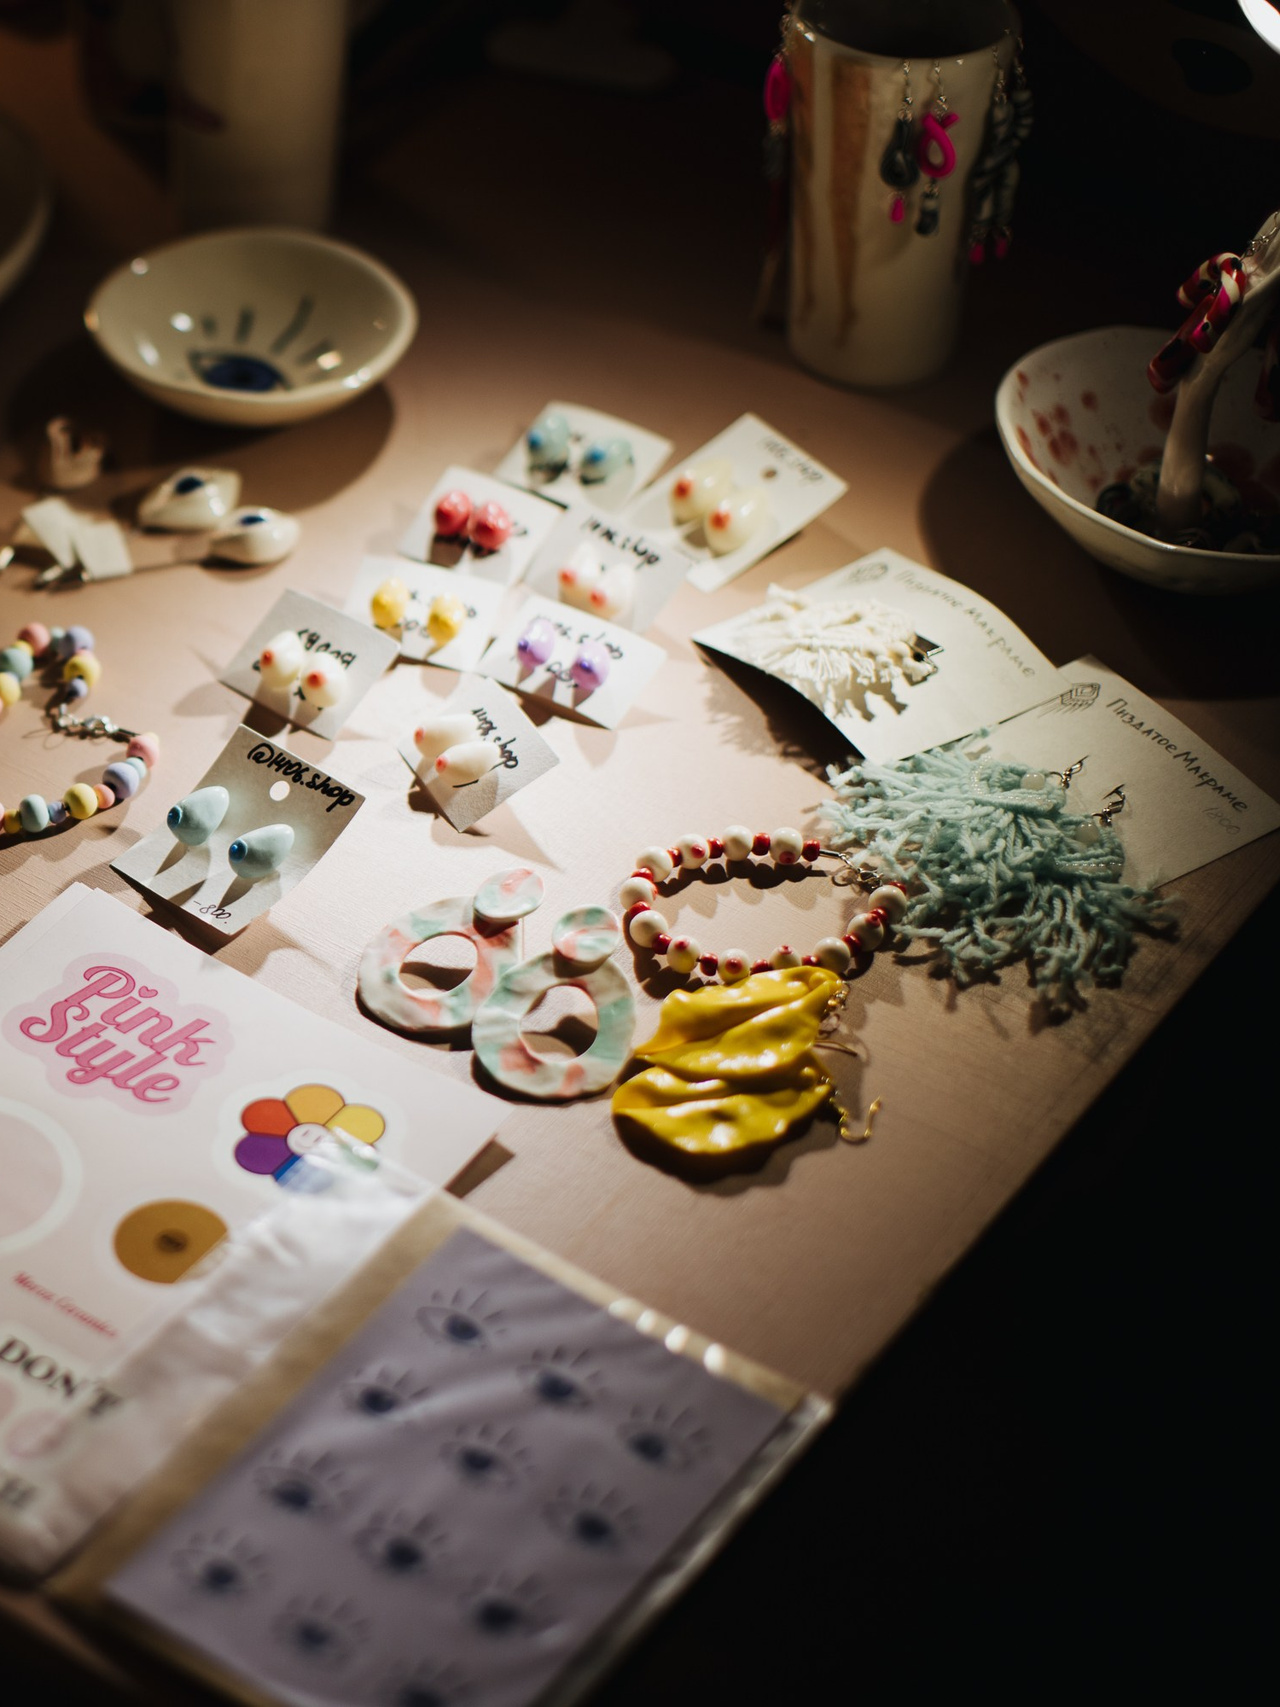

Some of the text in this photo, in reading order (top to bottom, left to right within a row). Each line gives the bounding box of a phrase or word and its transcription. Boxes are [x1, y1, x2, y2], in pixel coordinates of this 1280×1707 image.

[246, 742, 356, 813] @1406.shop
[19, 999, 181, 1103] Style
[64, 965, 217, 1066] Pink
